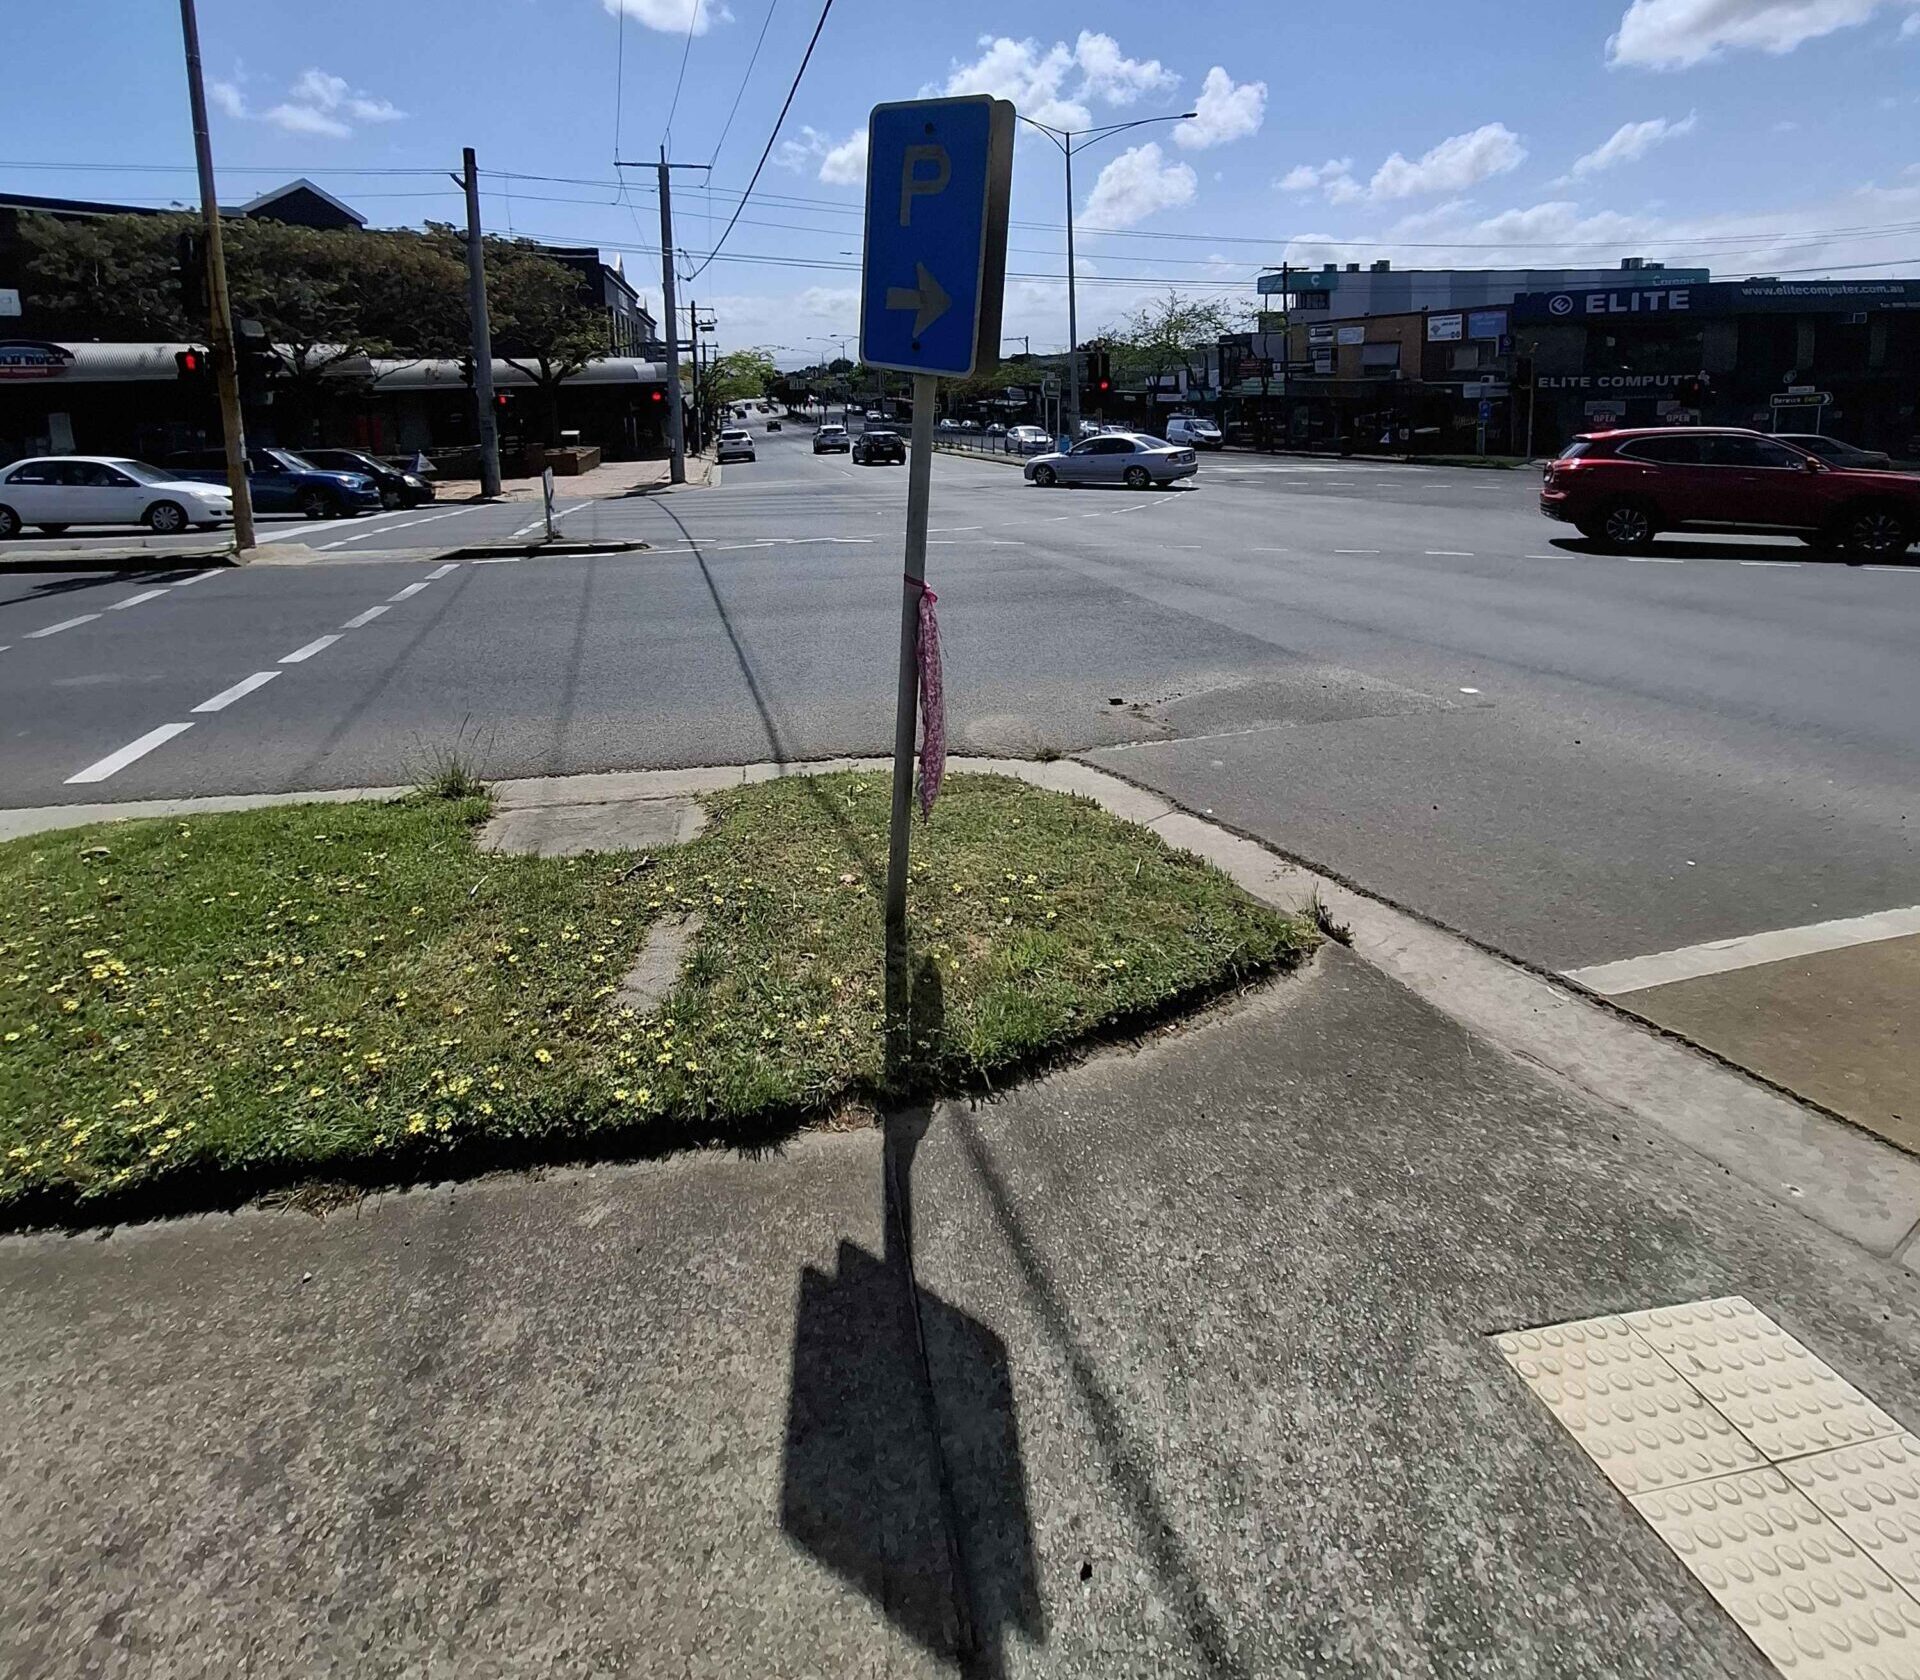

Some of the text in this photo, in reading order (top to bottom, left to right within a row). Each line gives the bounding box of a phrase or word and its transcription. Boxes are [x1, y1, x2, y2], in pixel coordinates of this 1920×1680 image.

[899, 144, 952, 227] P
[1740, 285, 1905, 297] www.elitecomputer.com.au
[1585, 289, 1691, 314] ELITE
[1538, 374, 1710, 388] ELITE COMPUT
[1593, 414, 1617, 423] OPEN
[1666, 414, 1690, 423] OPEN
